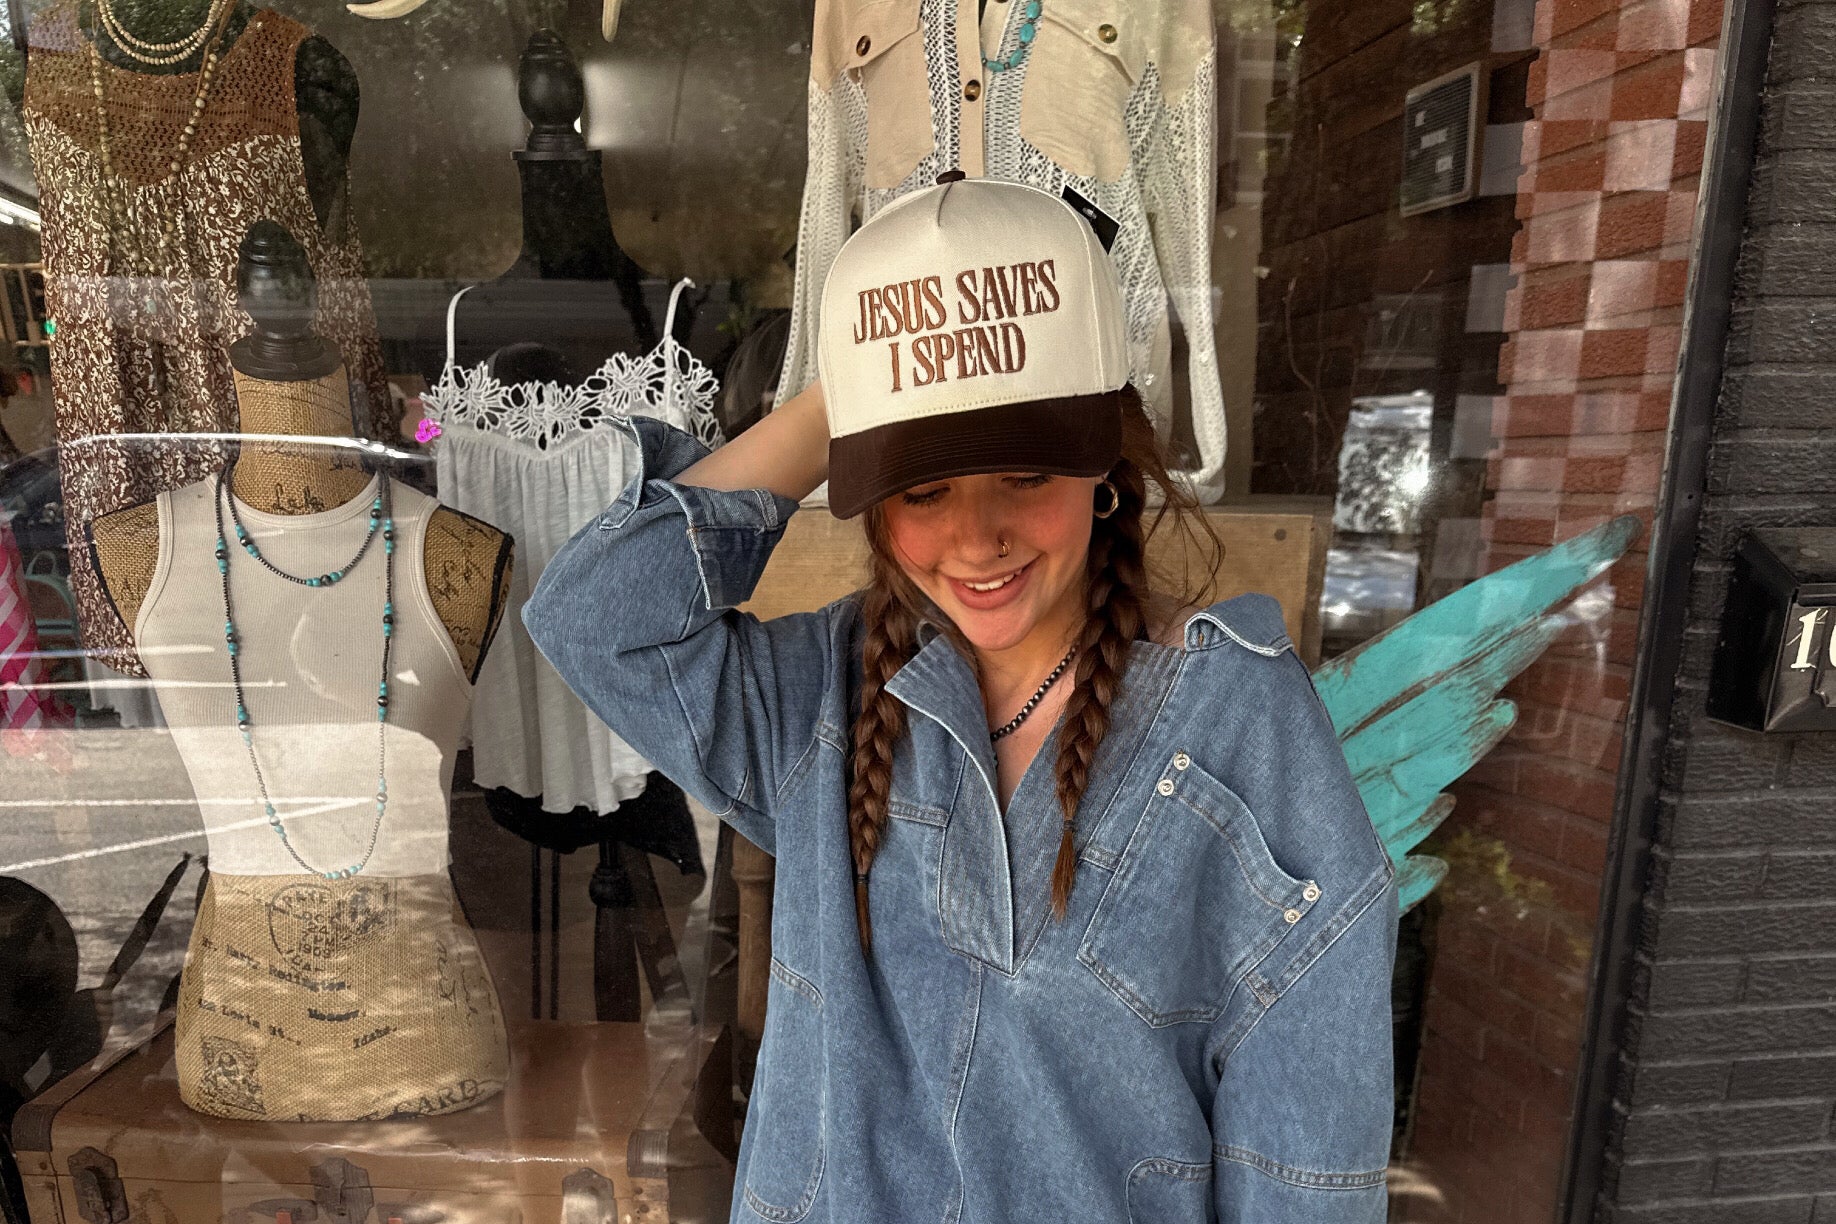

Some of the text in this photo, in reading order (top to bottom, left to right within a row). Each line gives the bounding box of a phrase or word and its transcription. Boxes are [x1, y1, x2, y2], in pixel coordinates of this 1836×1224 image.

[854, 259, 1060, 344] JESUS SAVES
[888, 322, 1026, 393] I SPEND
